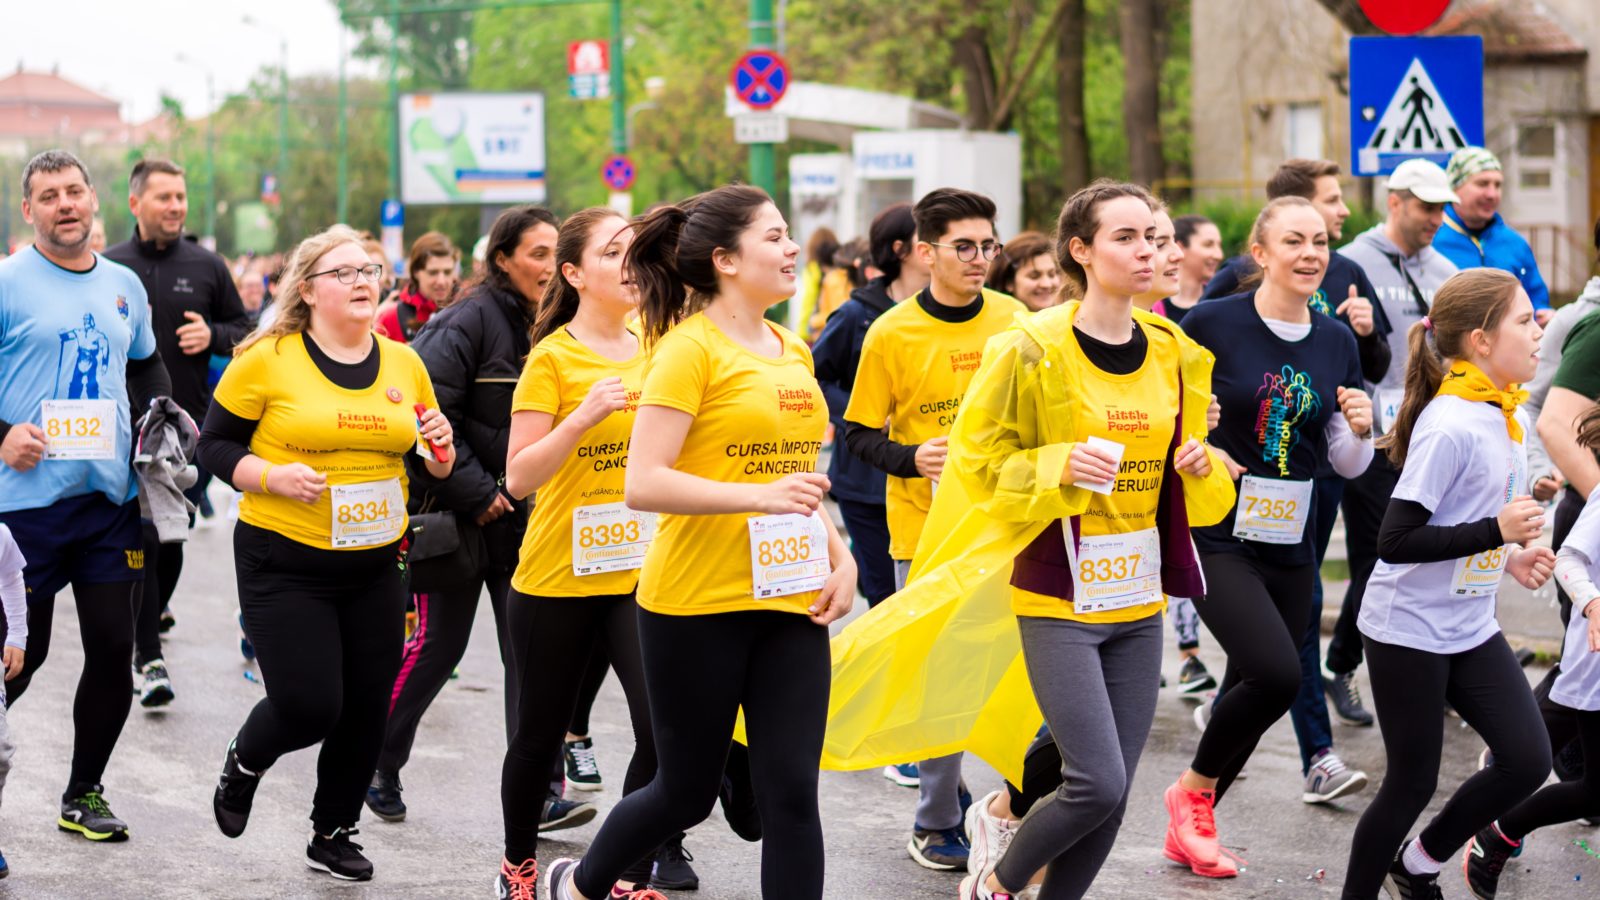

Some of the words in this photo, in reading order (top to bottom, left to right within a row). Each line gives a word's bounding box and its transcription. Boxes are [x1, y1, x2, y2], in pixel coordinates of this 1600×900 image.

[777, 388, 812, 400] Little
[779, 400, 813, 412] People
[919, 398, 959, 414] CURSA
[337, 412, 385, 422] Little
[1106, 409, 1148, 420] Little
[1258, 398, 1273, 444] TIMOTION
[47, 417, 101, 437] 8132
[337, 421, 388, 431] People
[1107, 421, 1150, 433] People
[578, 441, 624, 457] CURSA
[726, 442, 777, 457] CURSA
[1278, 421, 1291, 477] TIMOTION
[337, 498, 389, 524] 8334
[1244, 495, 1297, 520] 7352
[579, 520, 640, 548] 8393
[585, 547, 630, 561] Continental
[758, 535, 810, 567] 8335
[1079, 553, 1141, 583] 8337
[1086, 582, 1132, 598] Continental
